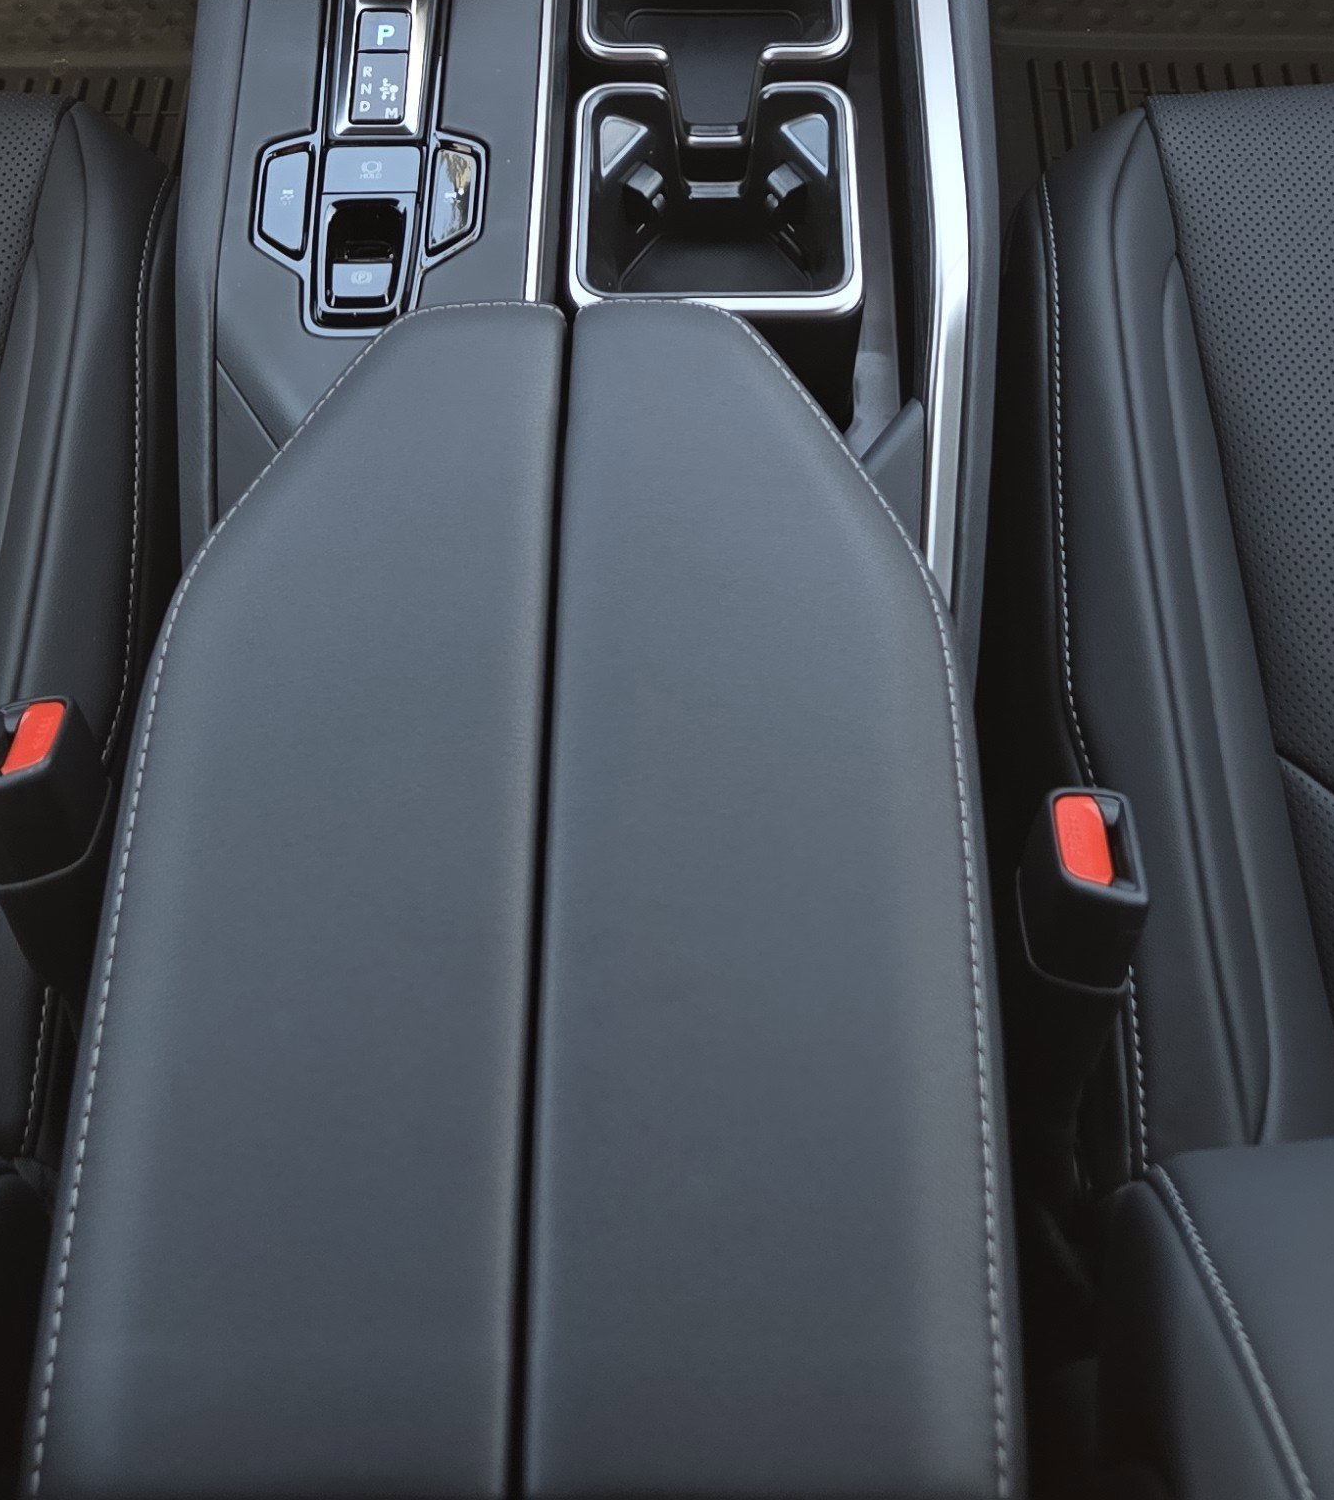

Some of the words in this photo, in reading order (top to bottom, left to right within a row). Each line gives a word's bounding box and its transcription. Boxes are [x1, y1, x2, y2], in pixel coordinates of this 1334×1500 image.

[377, 25, 395, 46] P
[362, 66, 373, 78] R
[360, 83, 372, 95] N
[359, 101, 371, 112] D
[385, 107, 398, 119] M
